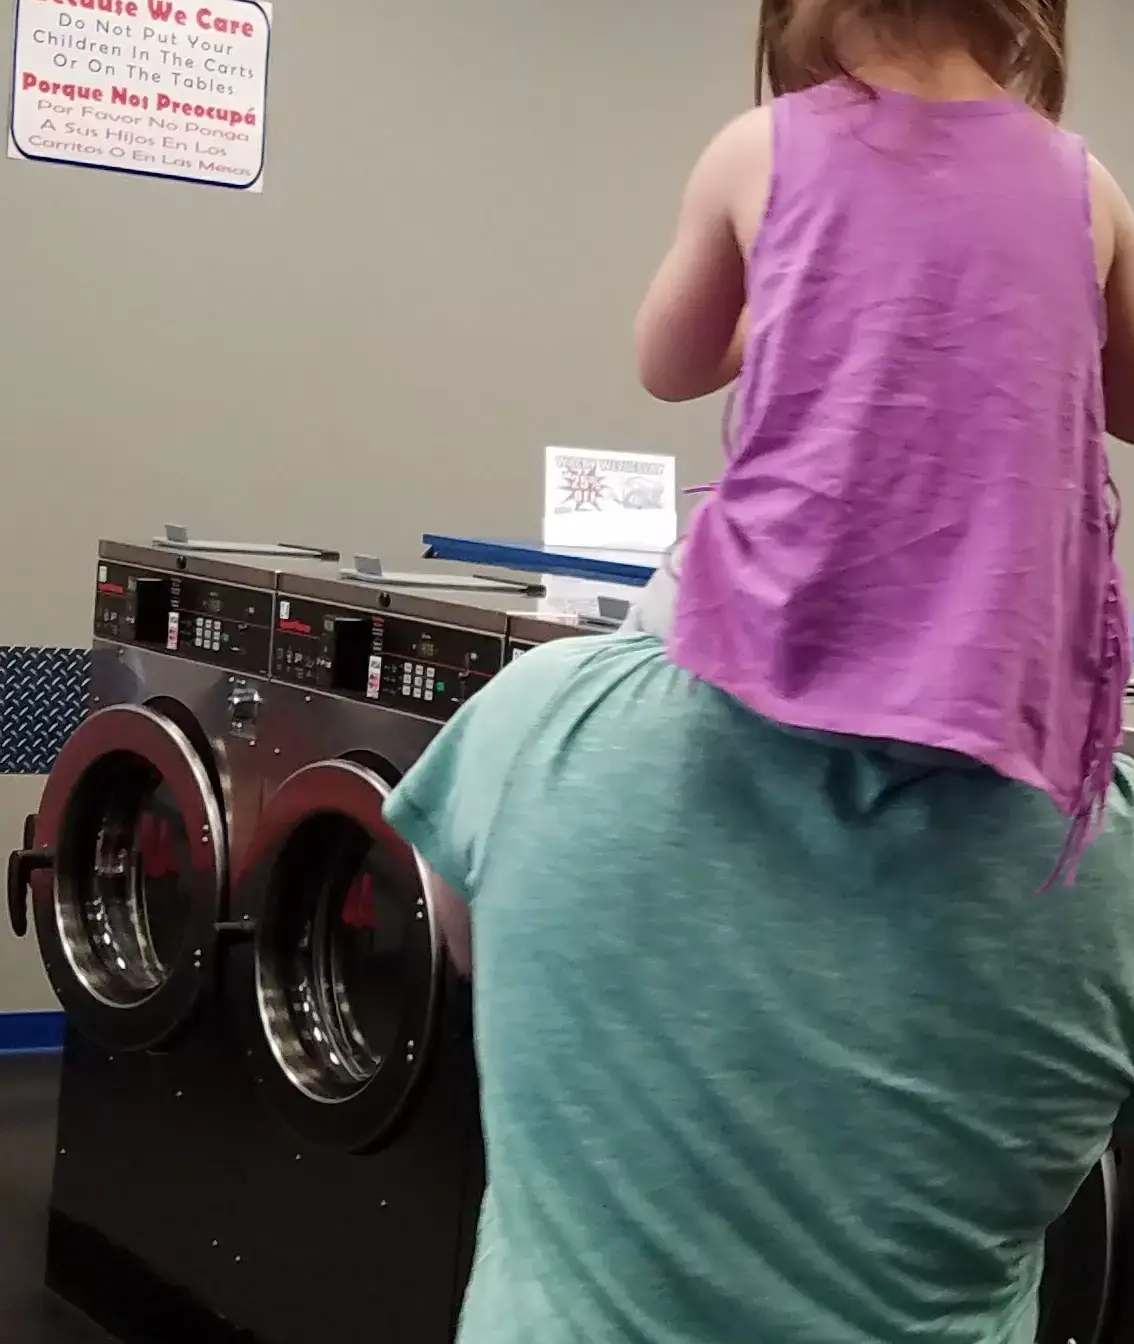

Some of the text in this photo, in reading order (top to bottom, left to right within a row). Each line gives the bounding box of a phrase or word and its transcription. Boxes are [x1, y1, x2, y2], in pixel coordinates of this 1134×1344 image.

[59, 12, 234, 56] Do Not Put Your
[196, 8, 254, 37] Care
[33, 29, 254, 79] Children In The Carts
[22, 72, 103, 101] Porque
[111, 86, 148, 110] Nos
[53, 54, 234, 95] Or On The Tables
[37, 100, 249, 142] Por Favor No Ponga
[40, 119, 227, 157] A Sus Hijos En Los
[28, 135, 102, 155] Carritos
[133, 150, 155, 163] En
[162, 156, 192, 168] Las
